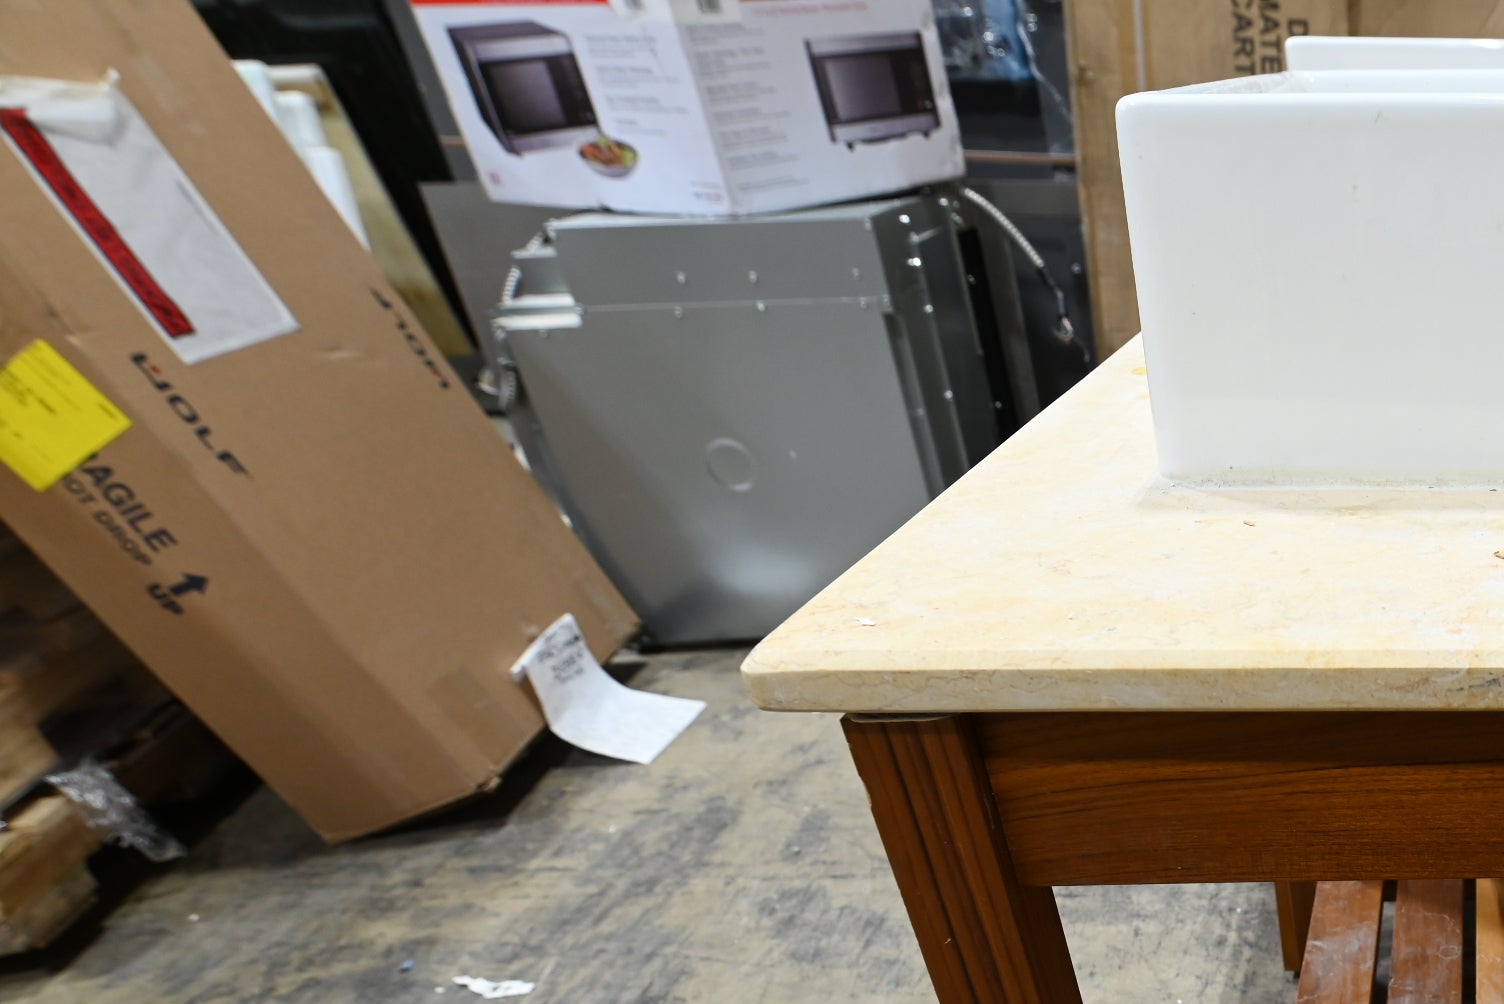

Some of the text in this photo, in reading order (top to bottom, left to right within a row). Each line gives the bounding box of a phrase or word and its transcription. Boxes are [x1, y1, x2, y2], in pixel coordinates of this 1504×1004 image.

[131, 352, 253, 478] WOLF
[64, 474, 97, 504] OT
[80, 453, 178, 552] AGILE
[147, 583, 184, 615] UP
